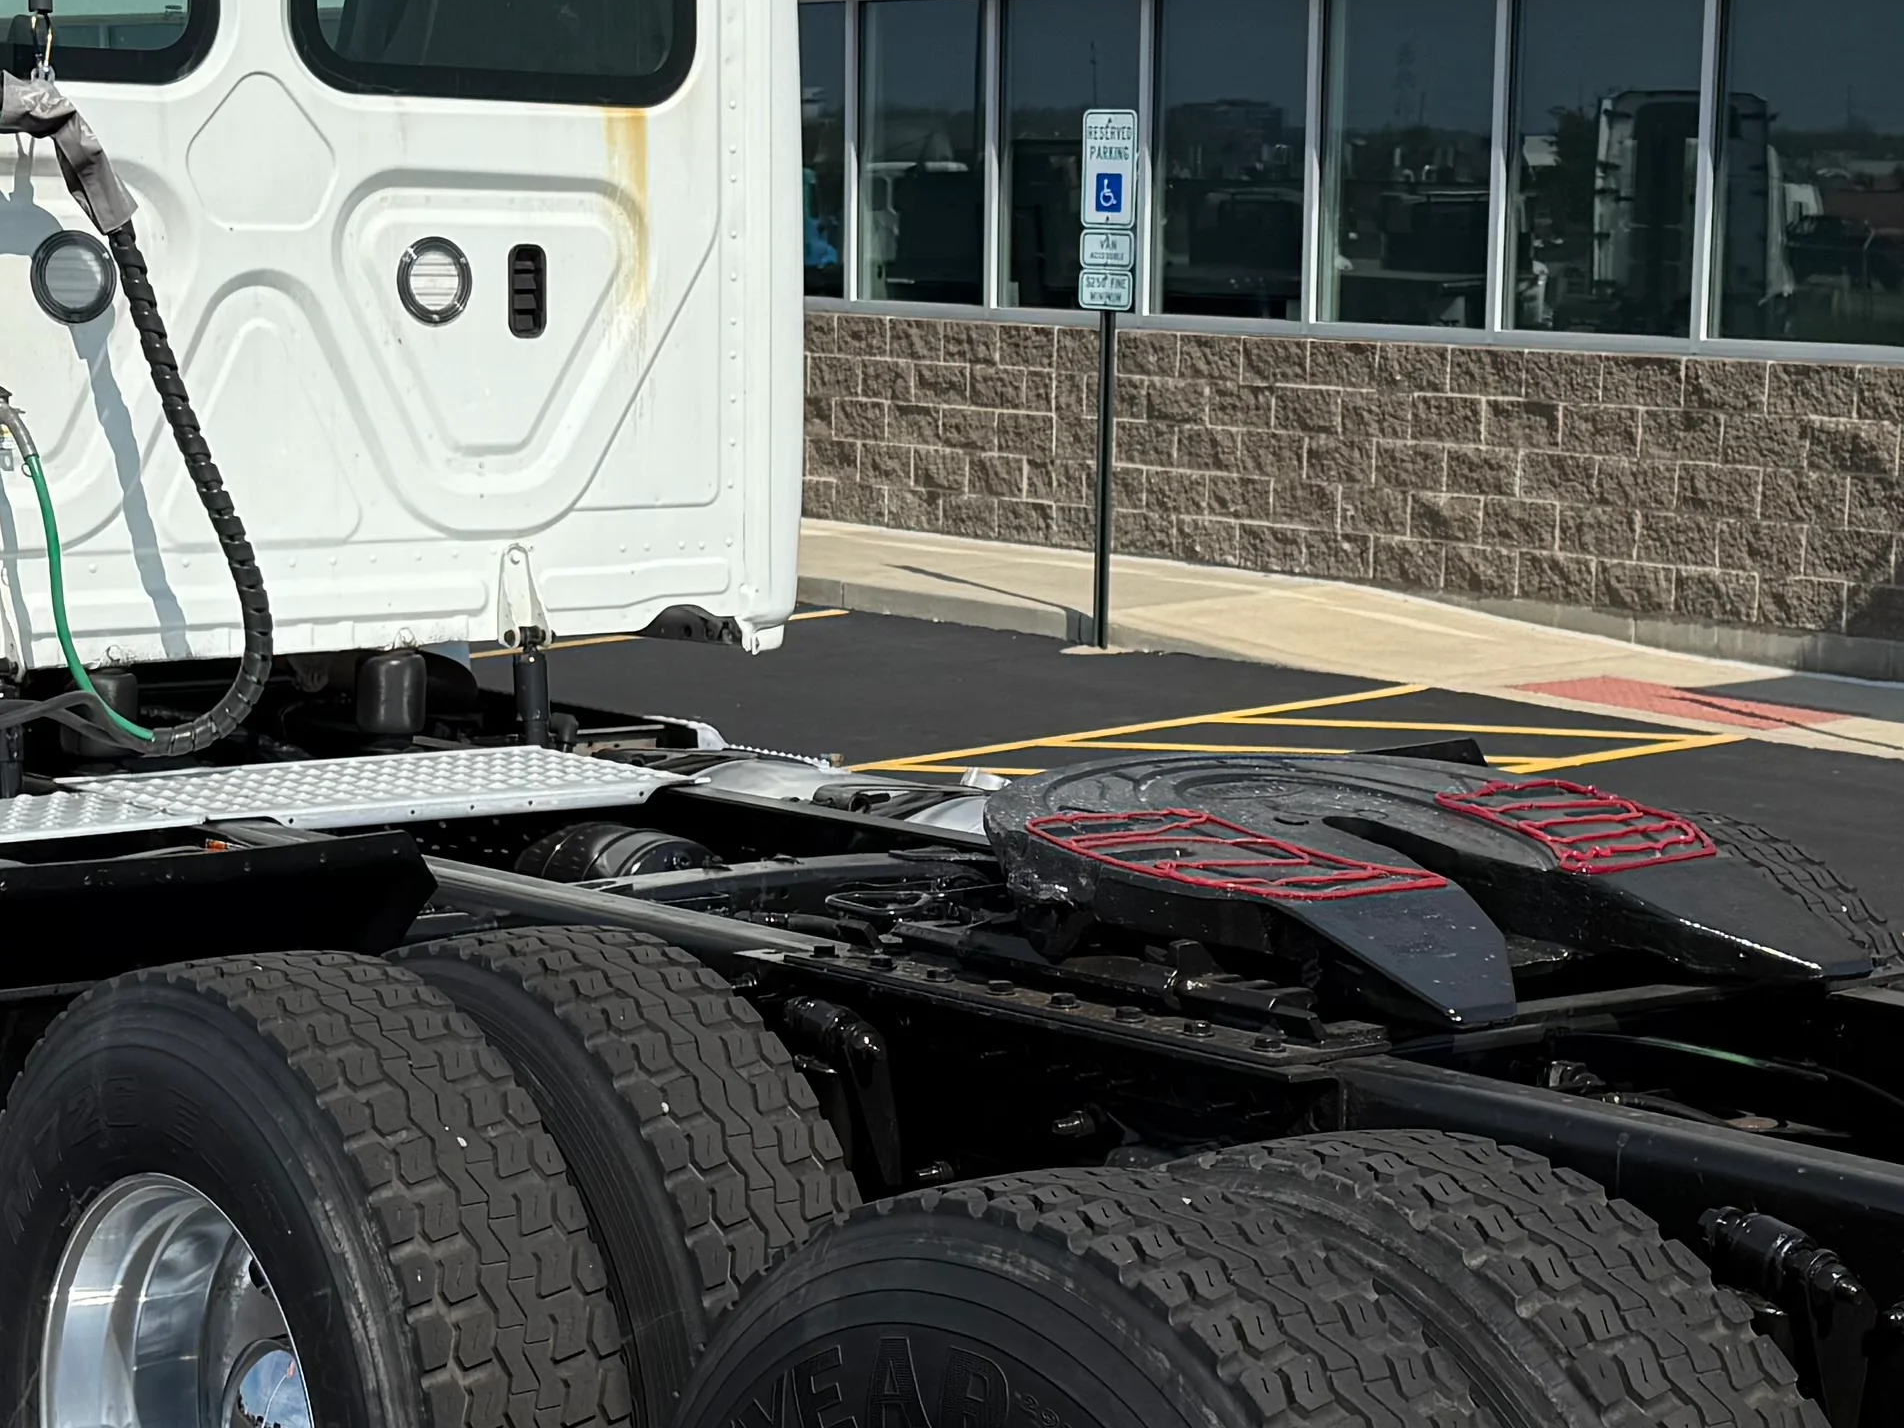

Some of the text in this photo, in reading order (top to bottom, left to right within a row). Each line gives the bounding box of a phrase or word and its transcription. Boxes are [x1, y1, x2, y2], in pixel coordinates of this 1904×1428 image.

[1087, 124, 1132, 141] RESERVED
[1089, 146, 1130, 161] PARKING
[1099, 239, 1118, 252] VAN
[1110, 277, 1127, 290] FINE
